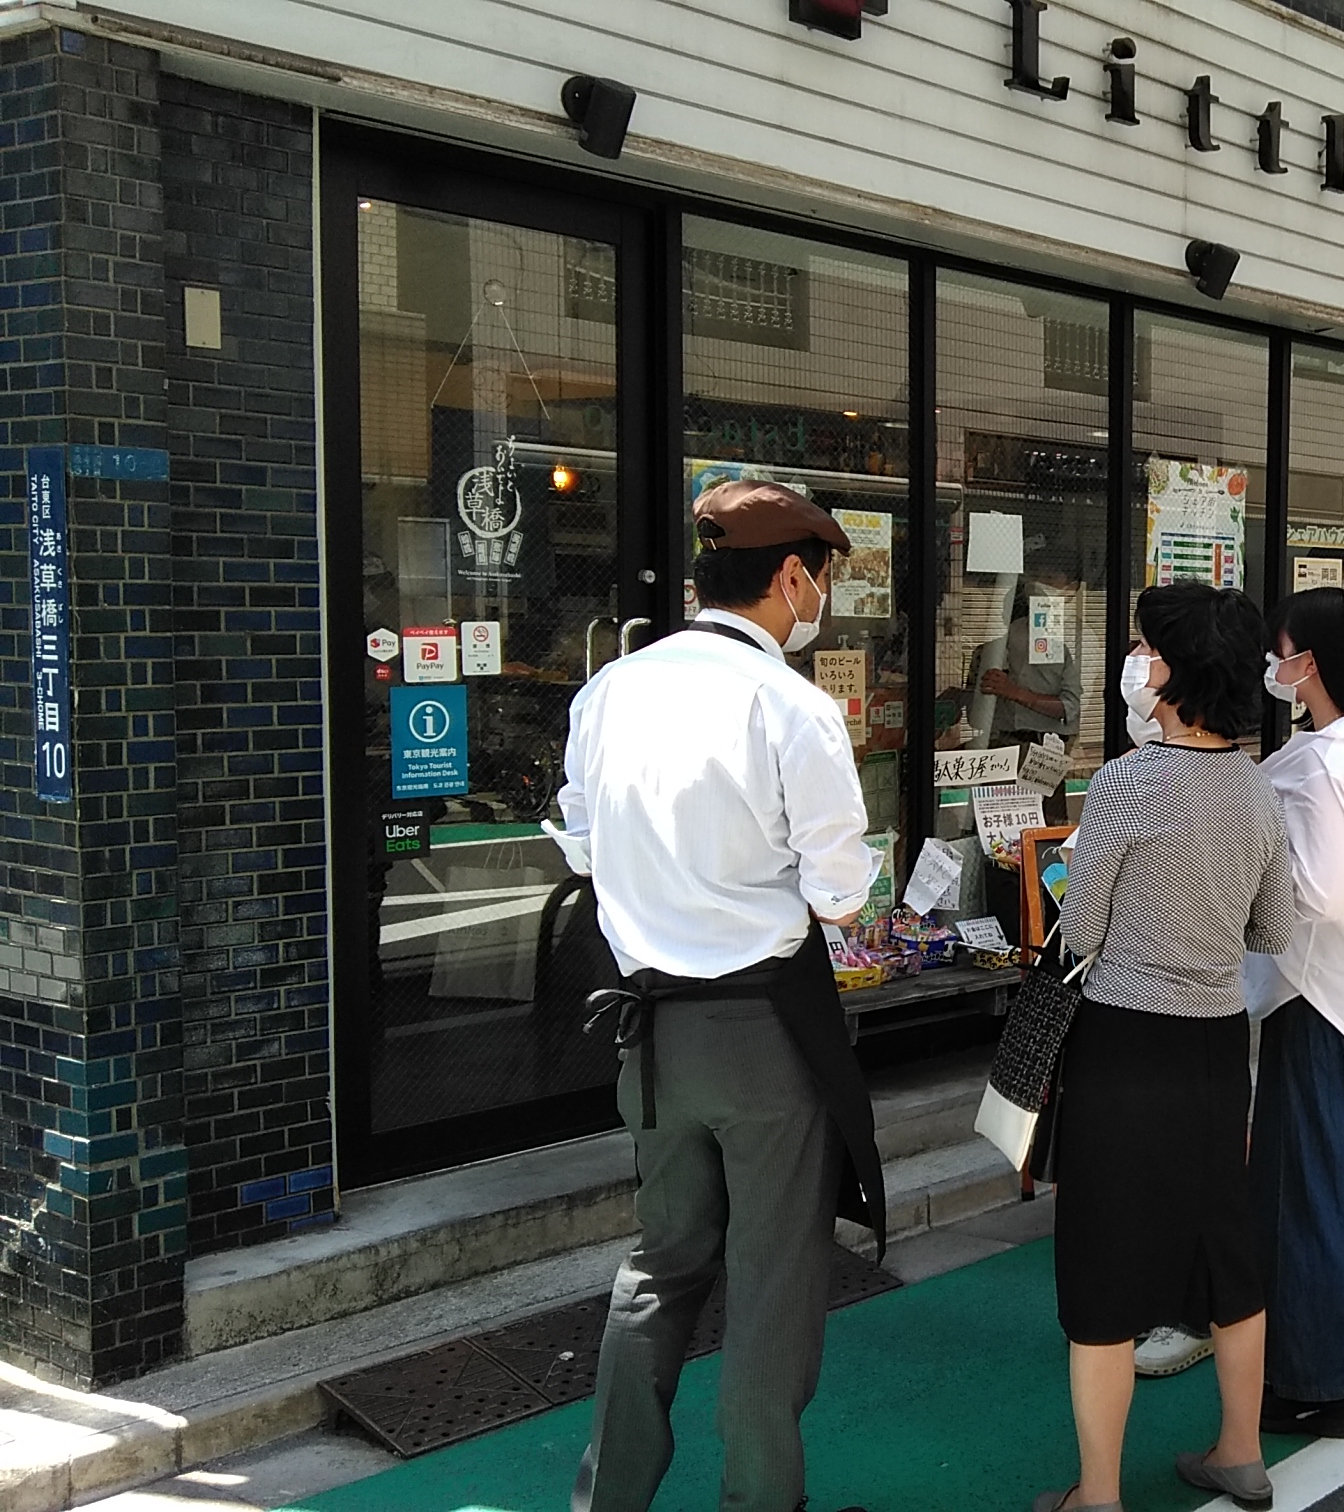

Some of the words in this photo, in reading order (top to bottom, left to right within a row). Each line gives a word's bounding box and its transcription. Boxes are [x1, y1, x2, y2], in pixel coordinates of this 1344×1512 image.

[30, 475, 38, 511] TAITO
[40, 473, 51, 519] 台東区
[464, 470, 505, 532] 浅草橋
[31, 514, 40, 545] CITY
[33, 558, 42, 658] ASAKUSABASHI
[39, 527, 59, 732] 浅草橋三丁目
[381, 638, 396, 647] Pay
[416, 662, 444, 671] PayPay
[819, 656, 861, 667] 旬のビール
[819, 669, 855, 680] いろいろ
[36, 671, 45, 731] 3-CHOME
[42, 741, 66, 779] 10
[402, 747, 457, 759] 東京観光案内
[407, 763, 428, 771] Tokyo
[429, 762, 453, 770] Tourist
[401, 771, 441, 779] Information
[442, 769, 459, 777] Desk
[385, 824, 420, 838] Uber
[386, 839, 421, 852] Eats
